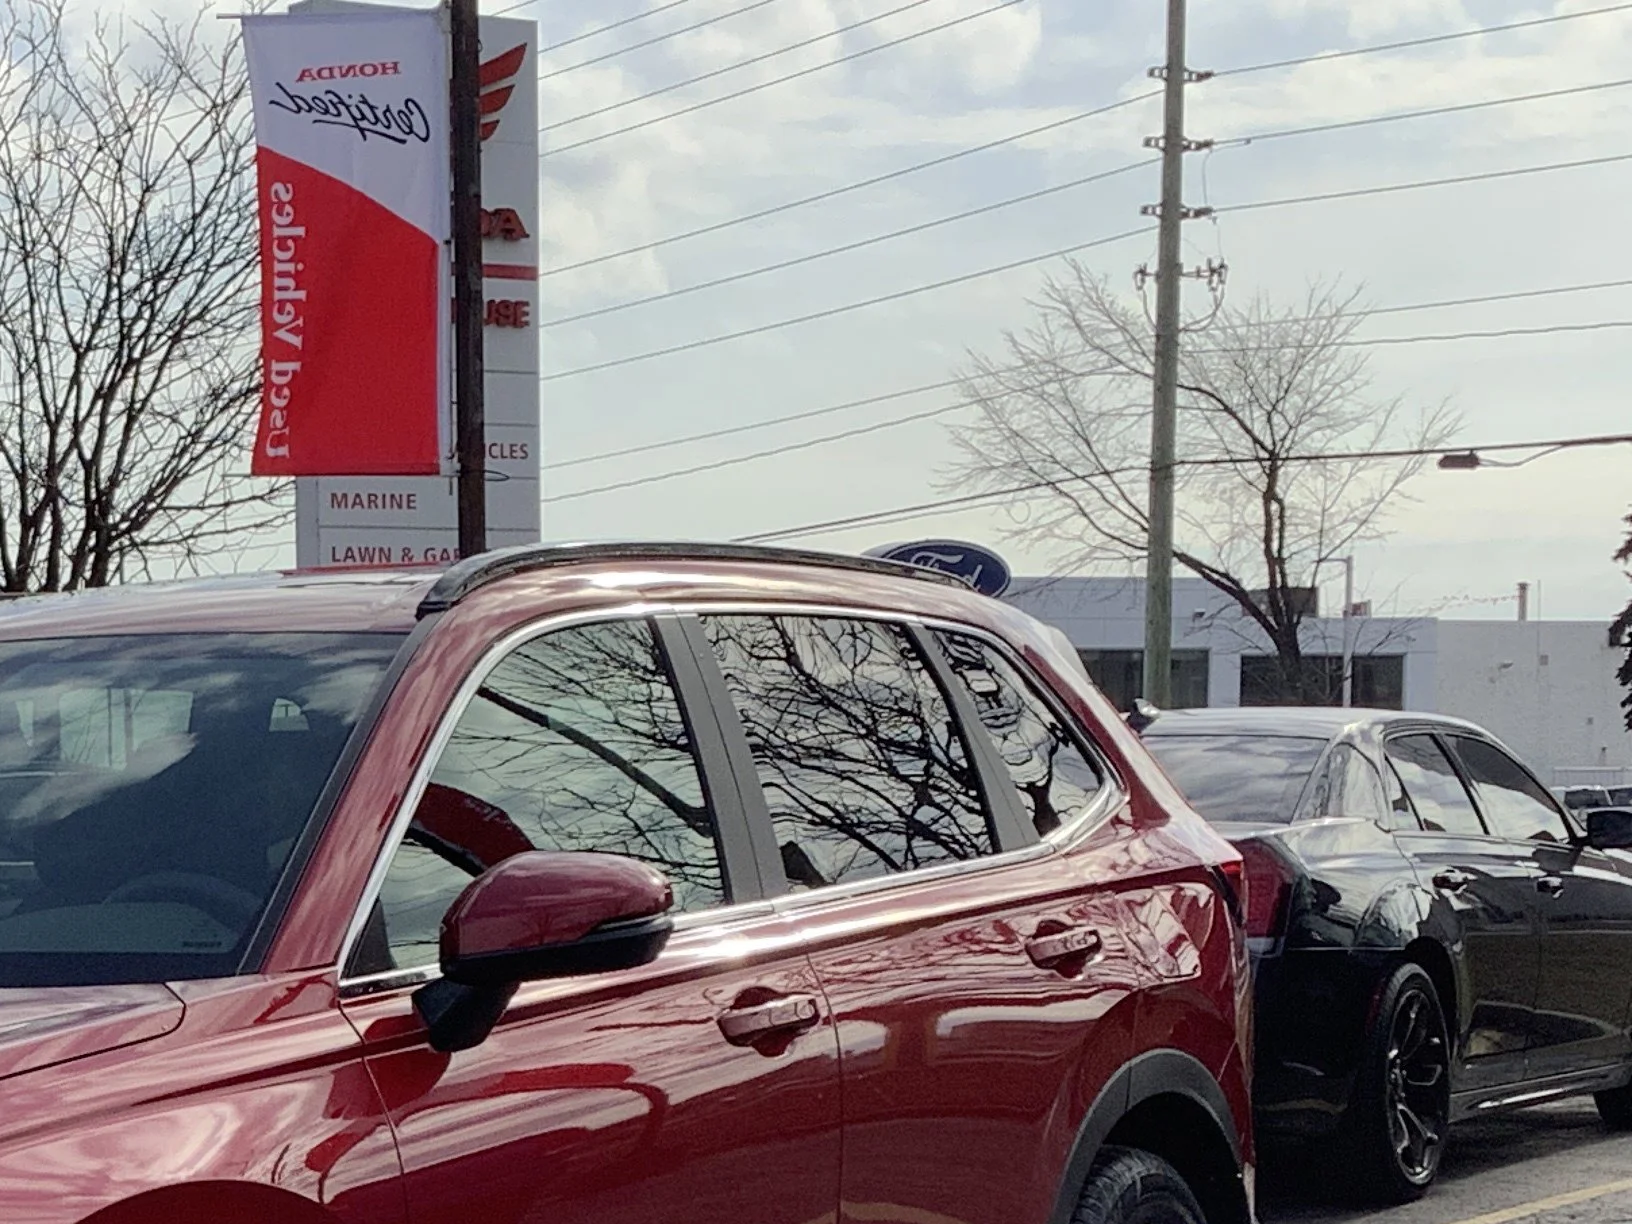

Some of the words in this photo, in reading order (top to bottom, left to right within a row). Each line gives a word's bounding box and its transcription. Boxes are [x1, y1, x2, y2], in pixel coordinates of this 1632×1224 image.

[330, 492, 417, 510] MARINE
[331, 546, 392, 563] LAWN
[401, 546, 414, 562] &
